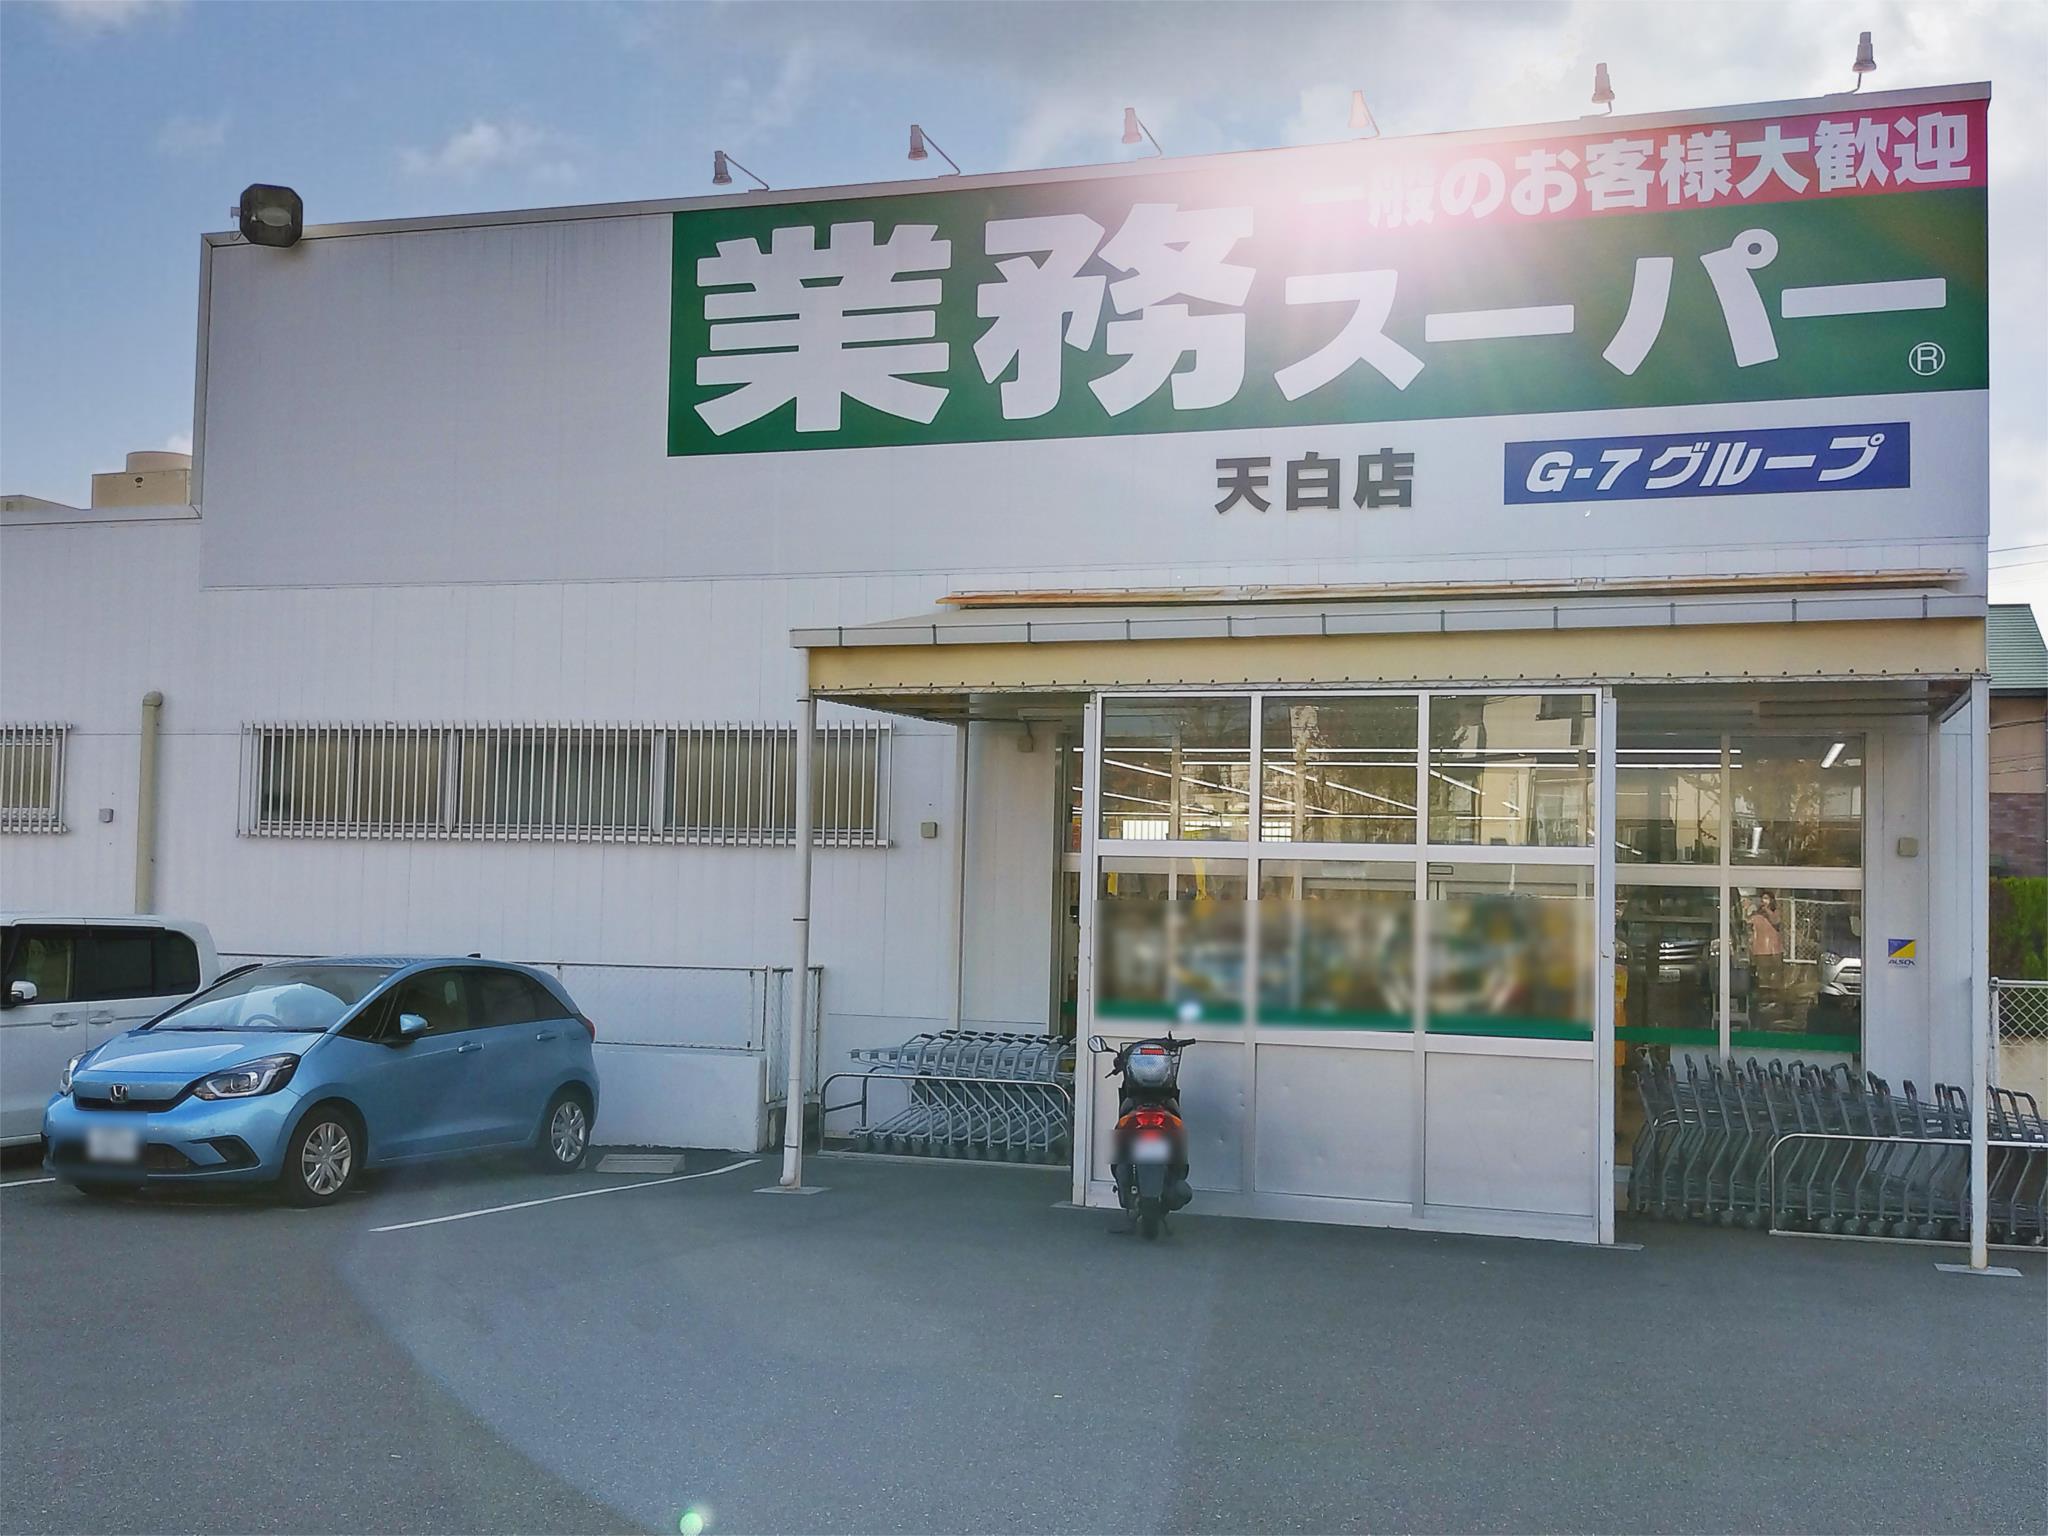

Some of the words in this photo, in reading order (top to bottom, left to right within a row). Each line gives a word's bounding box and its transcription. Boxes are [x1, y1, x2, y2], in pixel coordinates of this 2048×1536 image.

[694, 202, 1947, 436] 業務スーパー
[1214, 447, 1415, 514] 天白店
